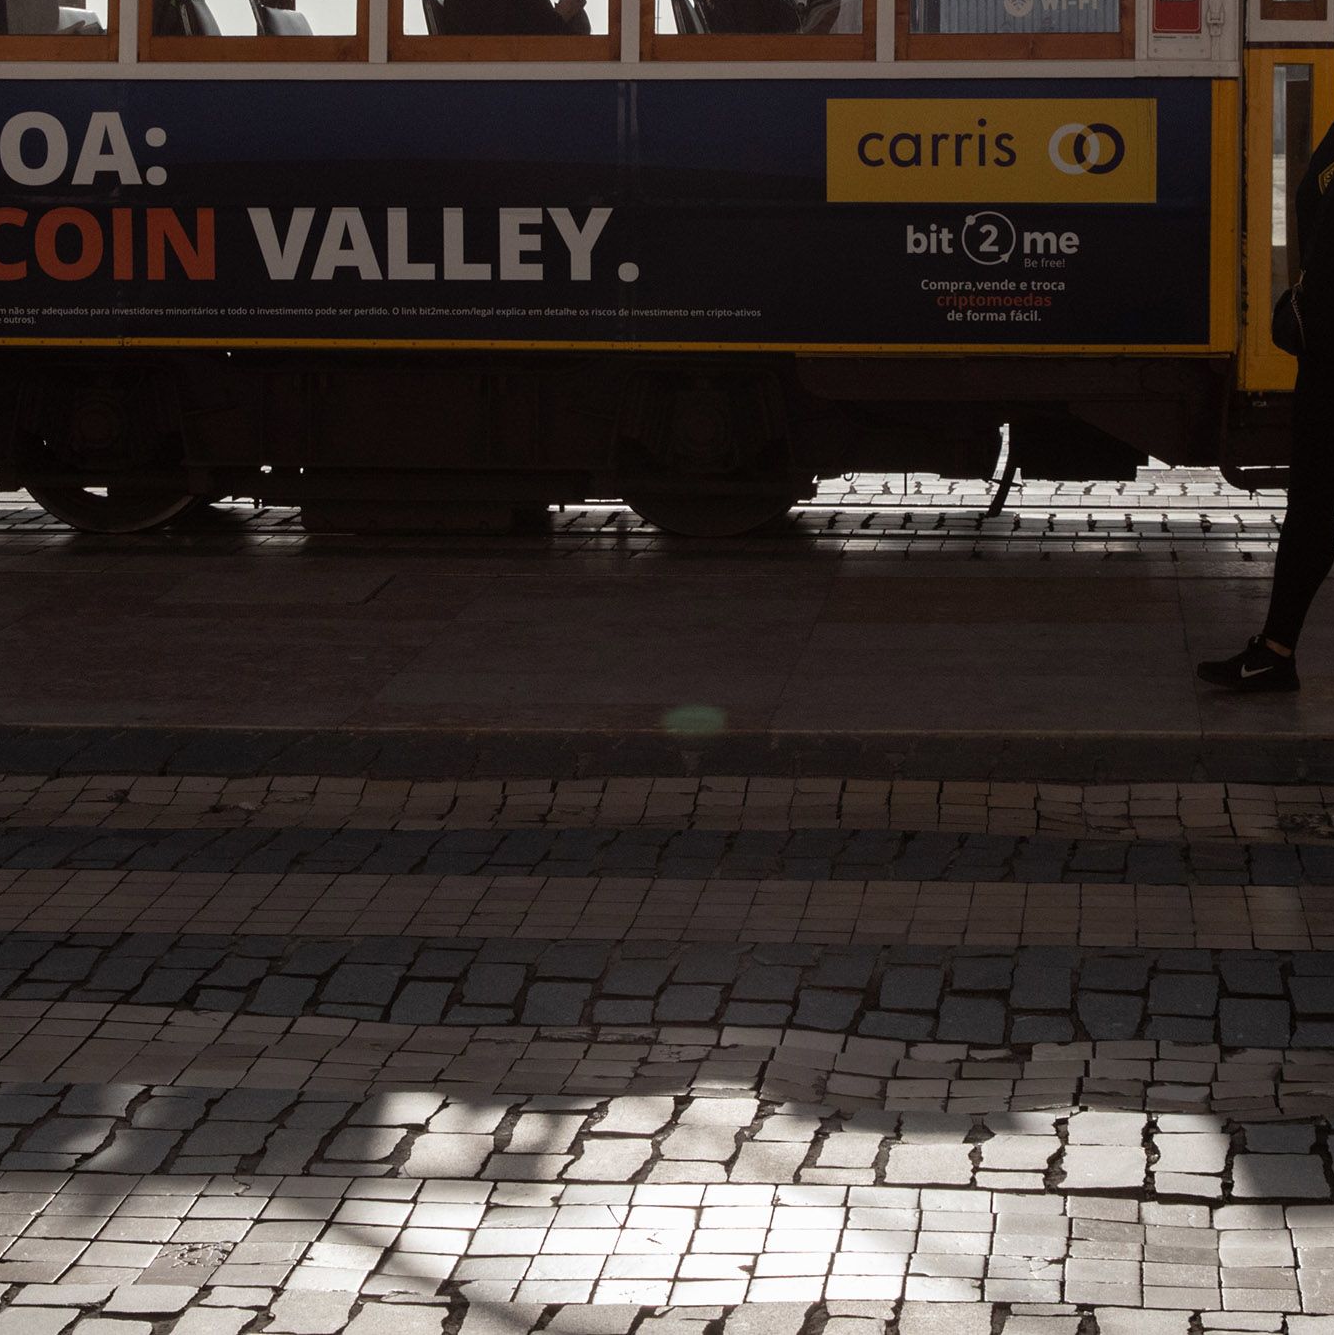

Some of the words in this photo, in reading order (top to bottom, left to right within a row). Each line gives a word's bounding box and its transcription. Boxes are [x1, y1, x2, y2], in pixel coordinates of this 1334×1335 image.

[857, 117, 1018, 168] carris
[247, 206, 640, 283] VALLEY.
[1024, 257, 1038, 269] Be
[1040, 257, 1066, 269] free!
[1019, 281, 1028, 292] e
[1030, 279, 1066, 292] troca
[936, 293, 1053, 310] criptomoedas
[8, 306, 25, 315] não
[41, 306, 89, 317] adequados
[90, 306, 110, 317] para
[111, 306, 164, 315] investidores
[165, 306, 219, 315] minoritários
[227, 306, 248, 315] todo
[256, 306, 314, 315] investimento
[315, 307, 338, 318] pode
[354, 307, 390, 318] perdido.
[401, 307, 418, 316] link
[419, 307, 494, 318] bit2me.com/legal
[495, 307, 527, 318] explica
[543, 307, 578, 316] detalhe
[591, 308, 617, 317] riscos
[631, 308, 689, 317] investimento
[706, 308, 762, 319] cripto-ativos
[946, 308, 964, 322] de
[966, 308, 1007, 322] forma
[1009, 308, 1043, 322] fácil.
